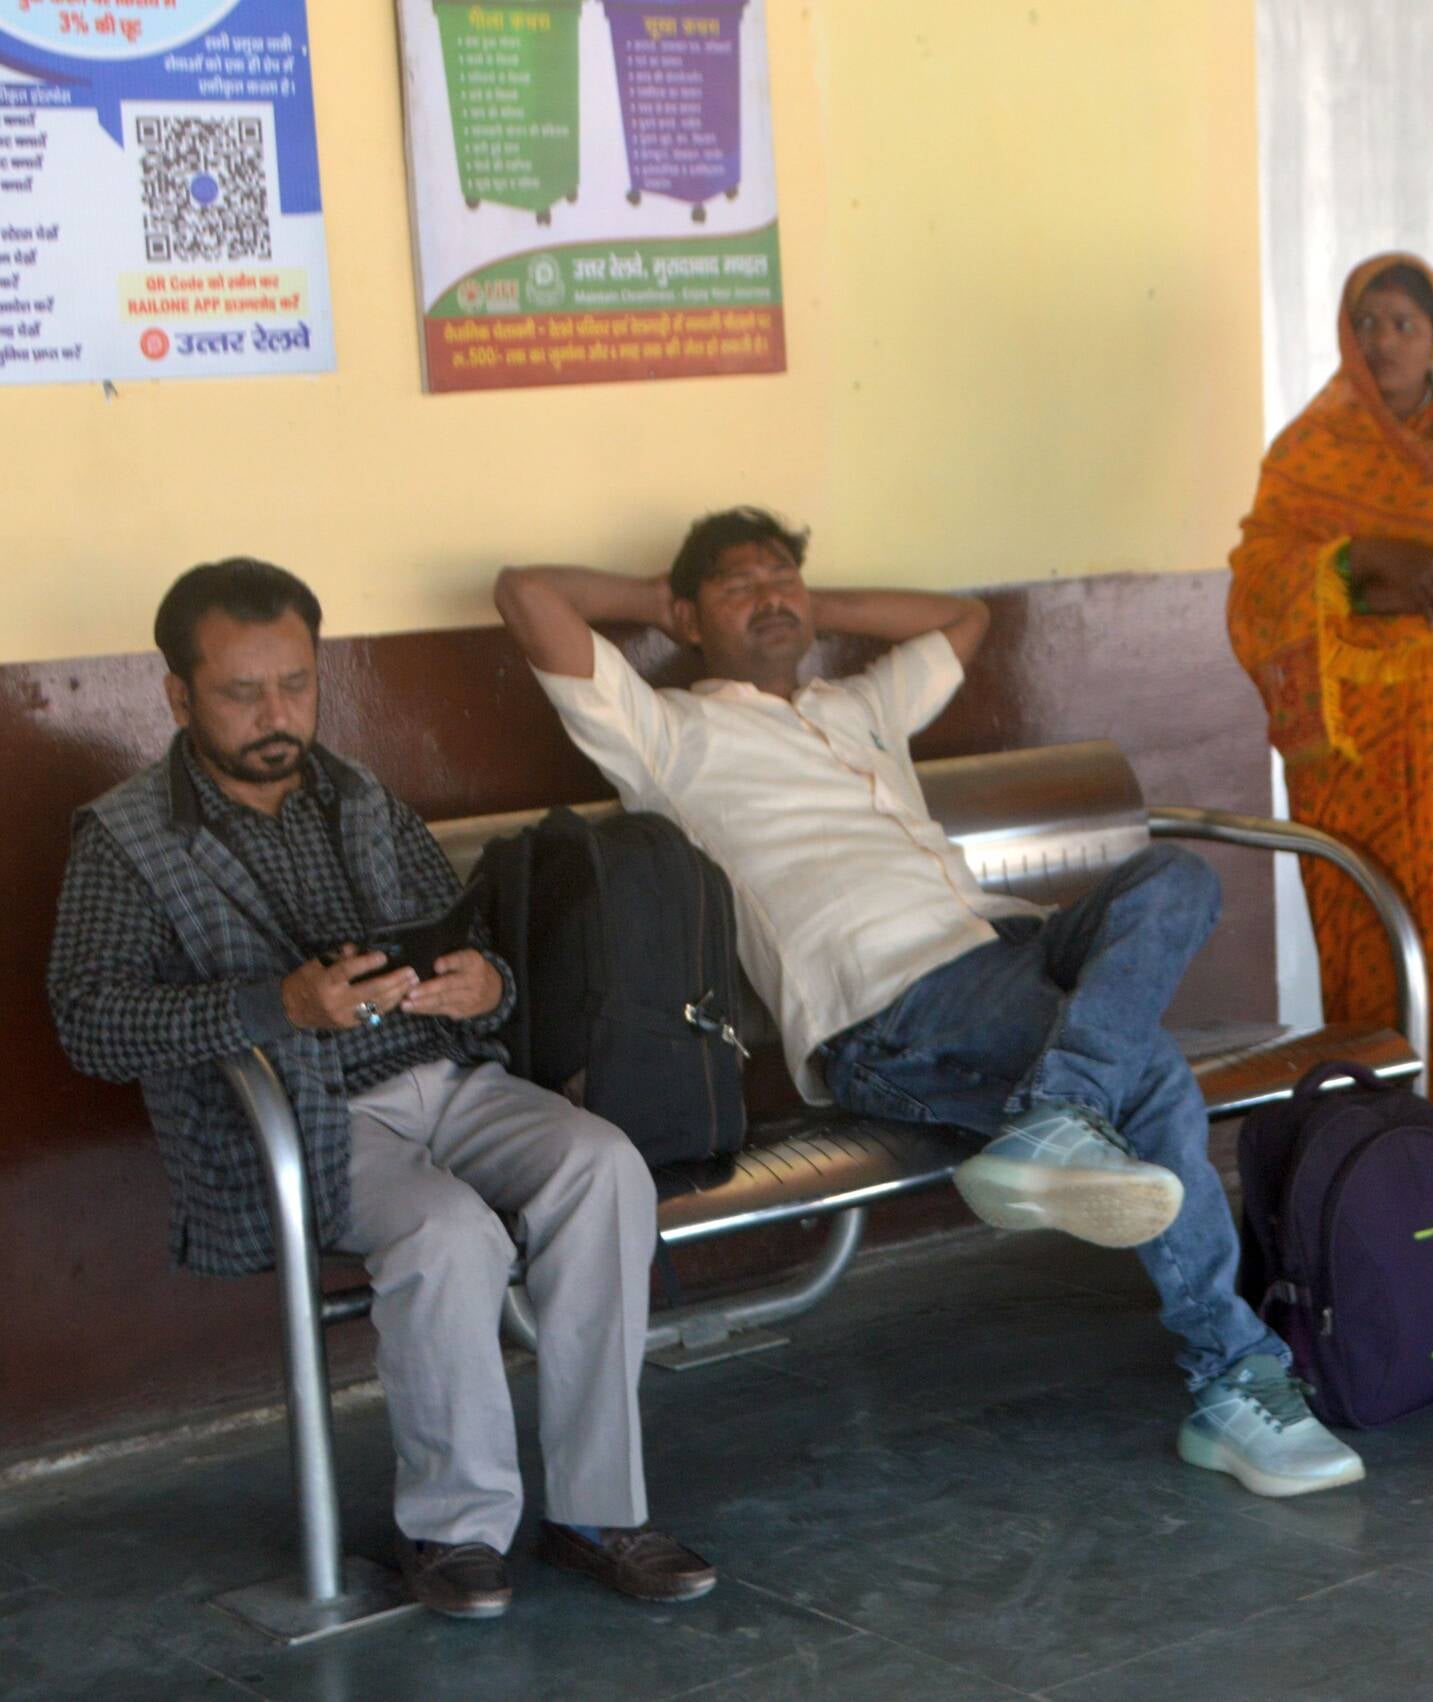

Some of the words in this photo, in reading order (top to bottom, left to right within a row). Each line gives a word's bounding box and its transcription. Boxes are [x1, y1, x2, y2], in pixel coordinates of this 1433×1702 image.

[60, 13, 89, 34] 3%
[147, 276, 166, 292] QR
[171, 277, 204, 291] Code
[129, 297, 189, 315] RAILONE
[195, 297, 221, 313] APP
[253, 320, 311, 352] रेलवे
